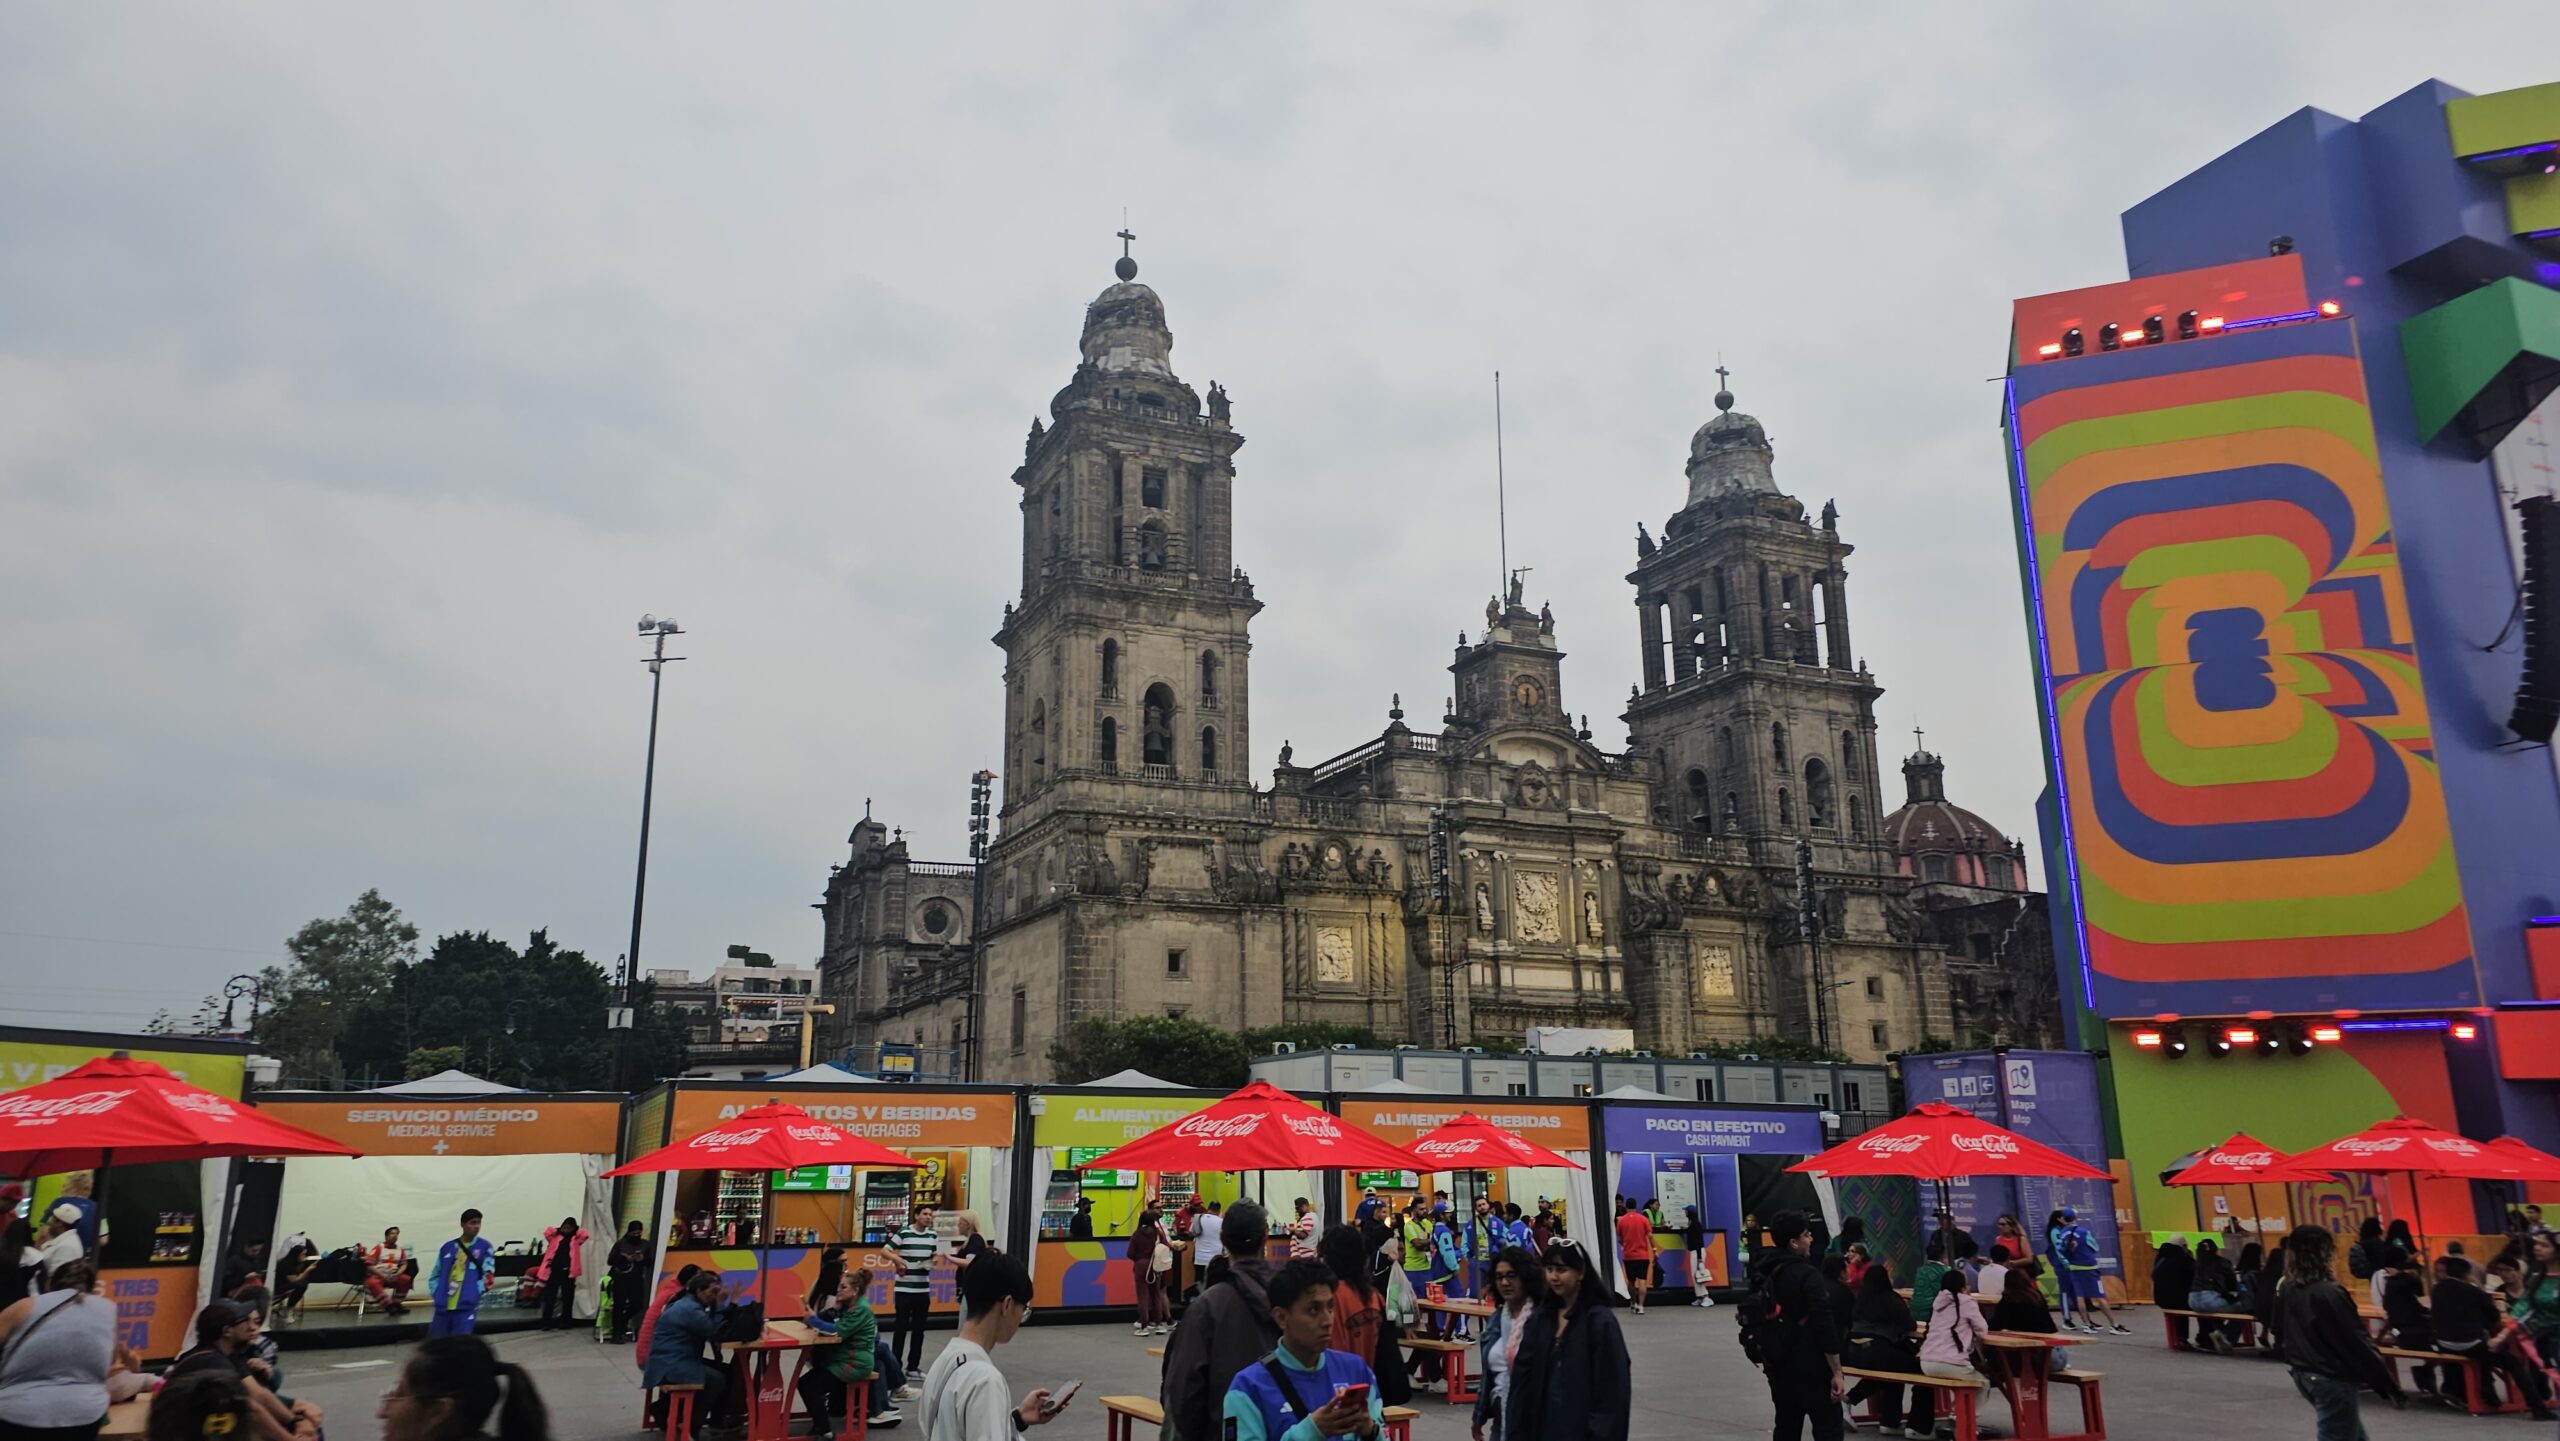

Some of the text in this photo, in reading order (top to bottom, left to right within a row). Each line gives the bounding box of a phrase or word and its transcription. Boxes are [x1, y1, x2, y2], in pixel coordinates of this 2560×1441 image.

[862, 1105, 877, 1120] Y
[881, 1106, 976, 1121] BEBIDAS
[2011, 1100, 2036, 1112] Mapa
[347, 1107, 538, 1123] SERVICIO MÉDICO
[1491, 1115, 1561, 1128] BEBIDAS
[2012, 1114, 2032, 1126] Map
[387, 1124, 496, 1137] MEDICAL SERVICE
[850, 1123, 920, 1138] BEVERAGES
[1645, 1118, 1786, 1134] PAGO EN EFECTIVO
[1685, 1133, 1750, 1148] CASH PAYMENT
[113, 1279, 159, 1297] TRES
